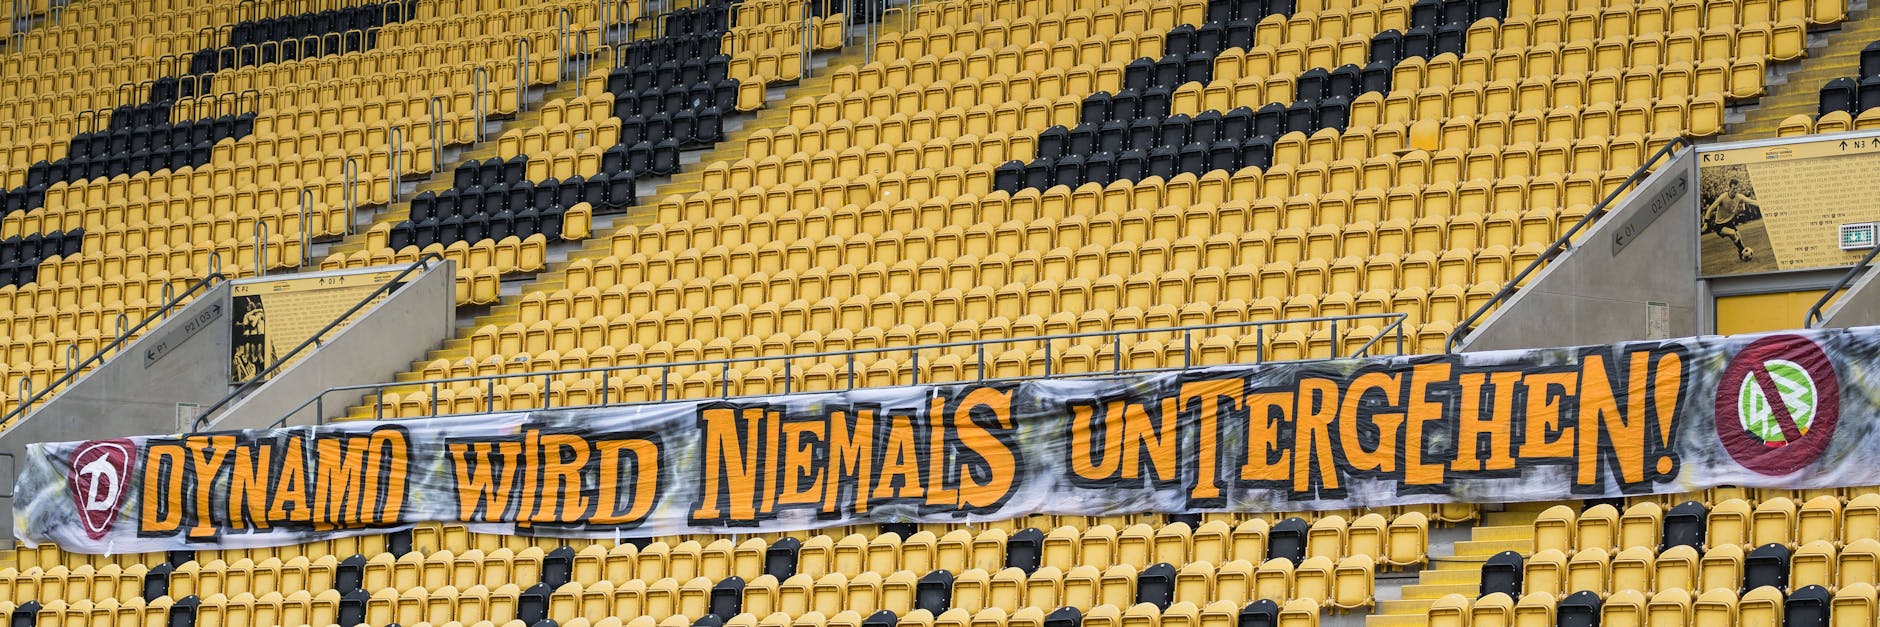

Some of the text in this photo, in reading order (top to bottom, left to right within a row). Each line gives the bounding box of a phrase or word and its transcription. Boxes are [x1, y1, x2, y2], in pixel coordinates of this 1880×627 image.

[1854, 141, 1865, 149] N3
[185, 322, 195, 334] P2
[157, 342, 167, 353] P1
[140, 350, 1688, 538] DYNAMO WIRD NIEMALS UNTERGEHEN!
